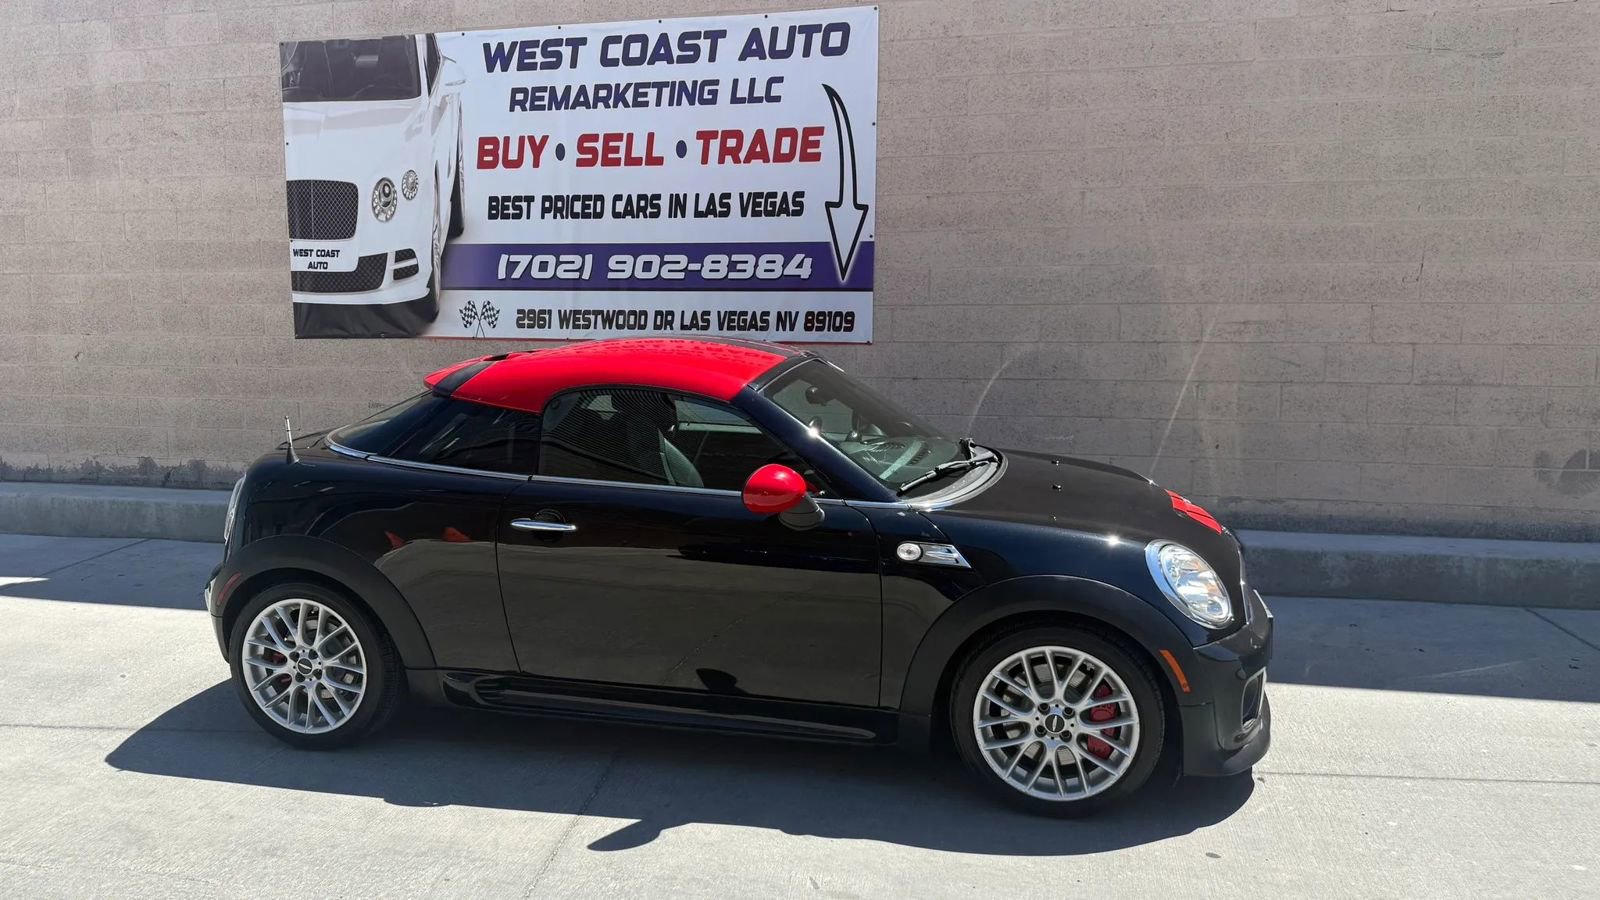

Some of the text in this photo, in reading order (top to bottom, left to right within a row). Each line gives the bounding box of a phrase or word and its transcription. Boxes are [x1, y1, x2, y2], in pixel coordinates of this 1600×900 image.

[483, 22, 851, 73] WEST COAST AUTO
[509, 76, 785, 112] REMARKETING LLC
[477, 126, 825, 169] BUY SELL TRADE
[488, 190, 805, 220] BEST PRICED CARS IN LAS VEGAS
[292, 248, 340, 258] WEST COAST
[307, 261, 328, 270] AUTO
[607, 253, 813, 280] 902-8384
[516, 308, 856, 332] 2961 WESTWOOD DR LAS VEGAS NV 89109
